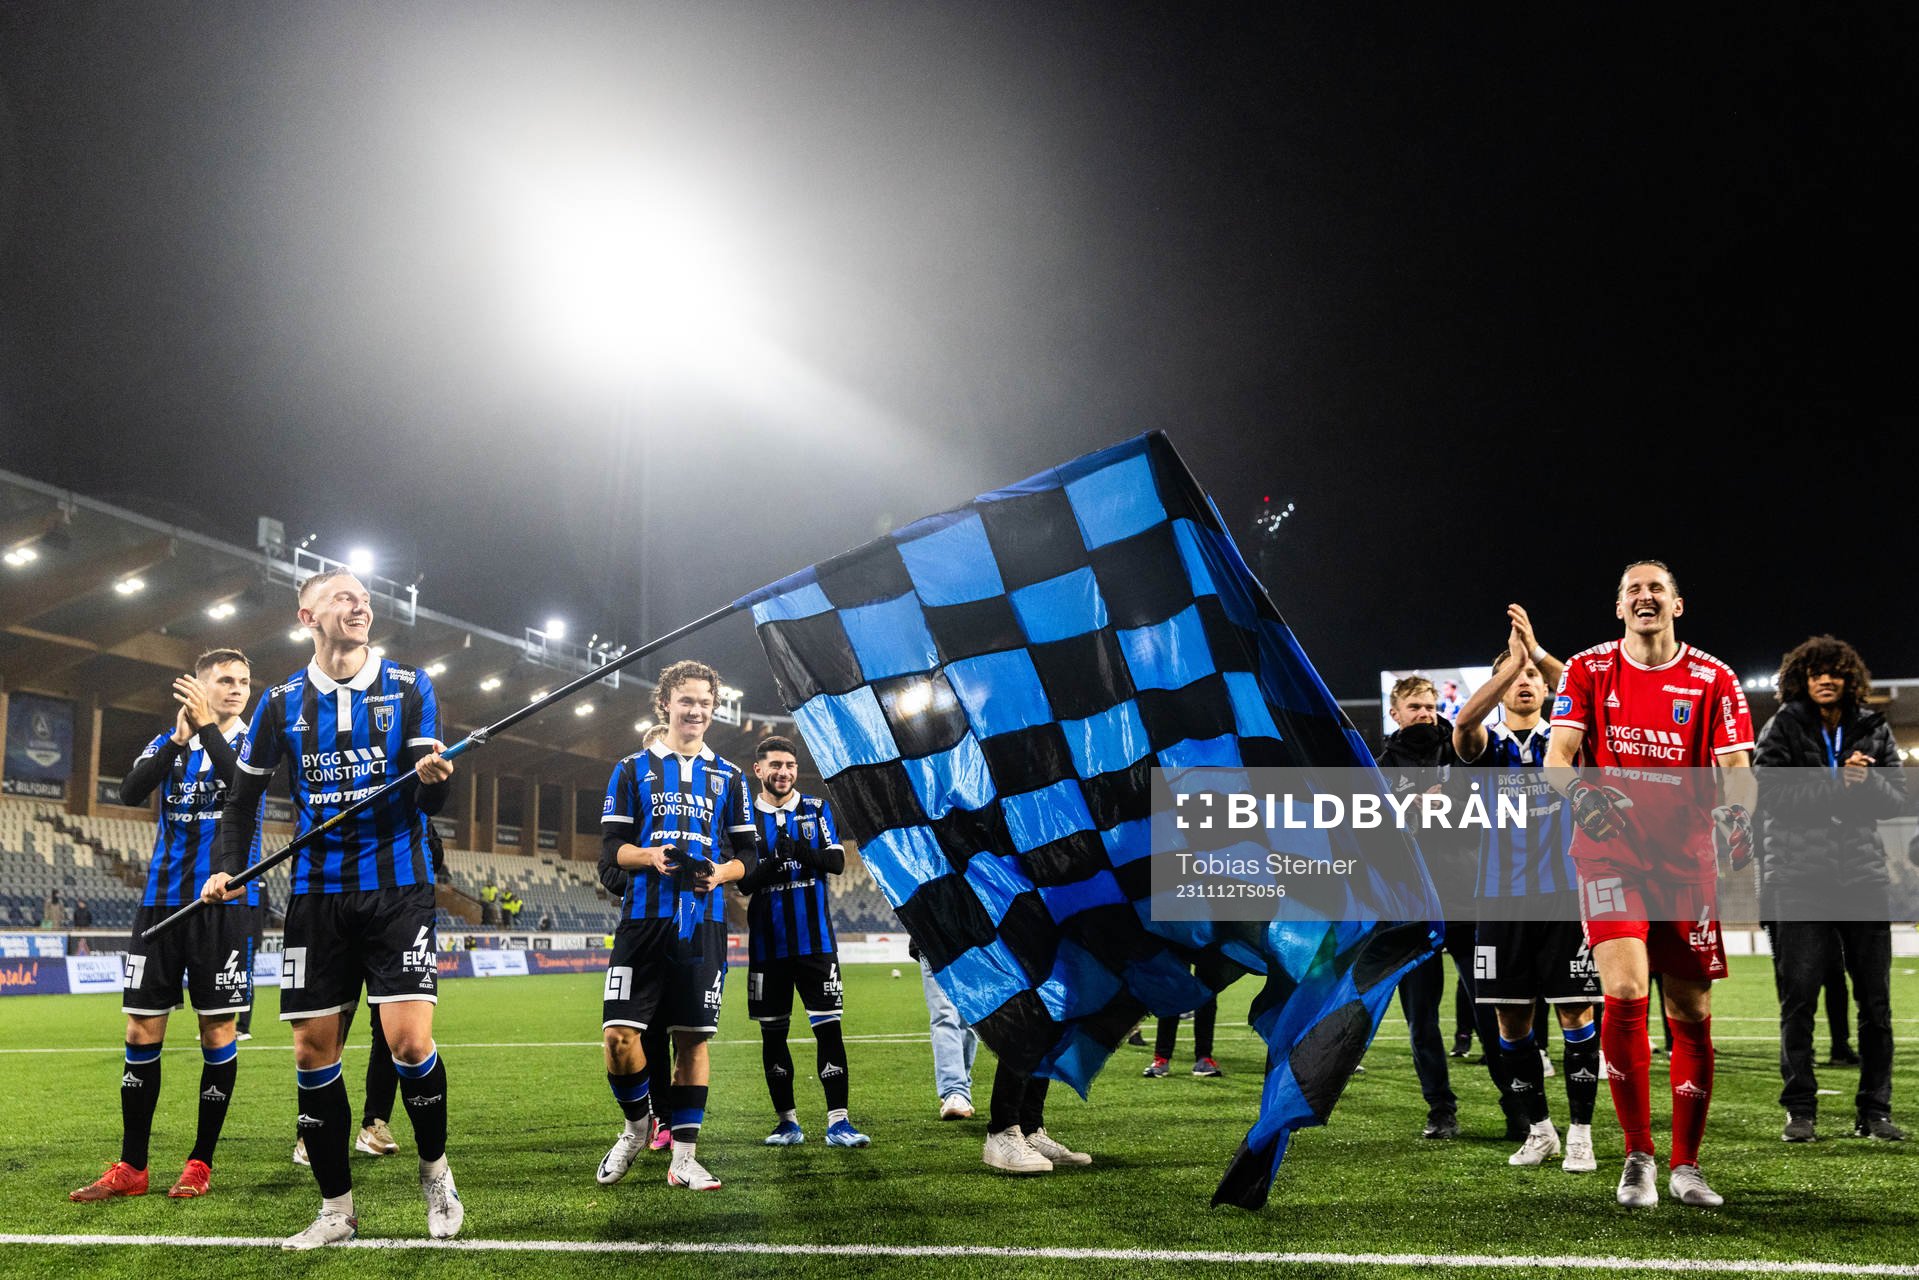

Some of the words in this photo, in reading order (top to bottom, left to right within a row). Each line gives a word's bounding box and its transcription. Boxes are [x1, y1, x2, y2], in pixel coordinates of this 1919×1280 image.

[1721, 696, 1737, 742] stadium
[1605, 726, 1641, 741] BYGG
[1606, 739, 1686, 761] CONSTRUCT
[301, 751, 341, 768] BYGG
[304, 759, 388, 782] CONSTRUCT
[1604, 766, 1640, 780] TOYO
[1641, 770, 1683, 785] TIRES
[1497, 774, 1525, 785] BYGG
[309, 791, 343, 805] TOYO
[651, 791, 682, 805] BYGG
[1497, 783, 1556, 797] CONSTRUC
[741, 781, 751, 822] stadium
[1529, 801, 1562, 817] TIRES
[652, 804, 714, 823] CONSTRUCT
[650, 831, 680, 841] TOYO
[682, 832, 713, 847] TIRES
[419, 981, 434, 989] SELECT
